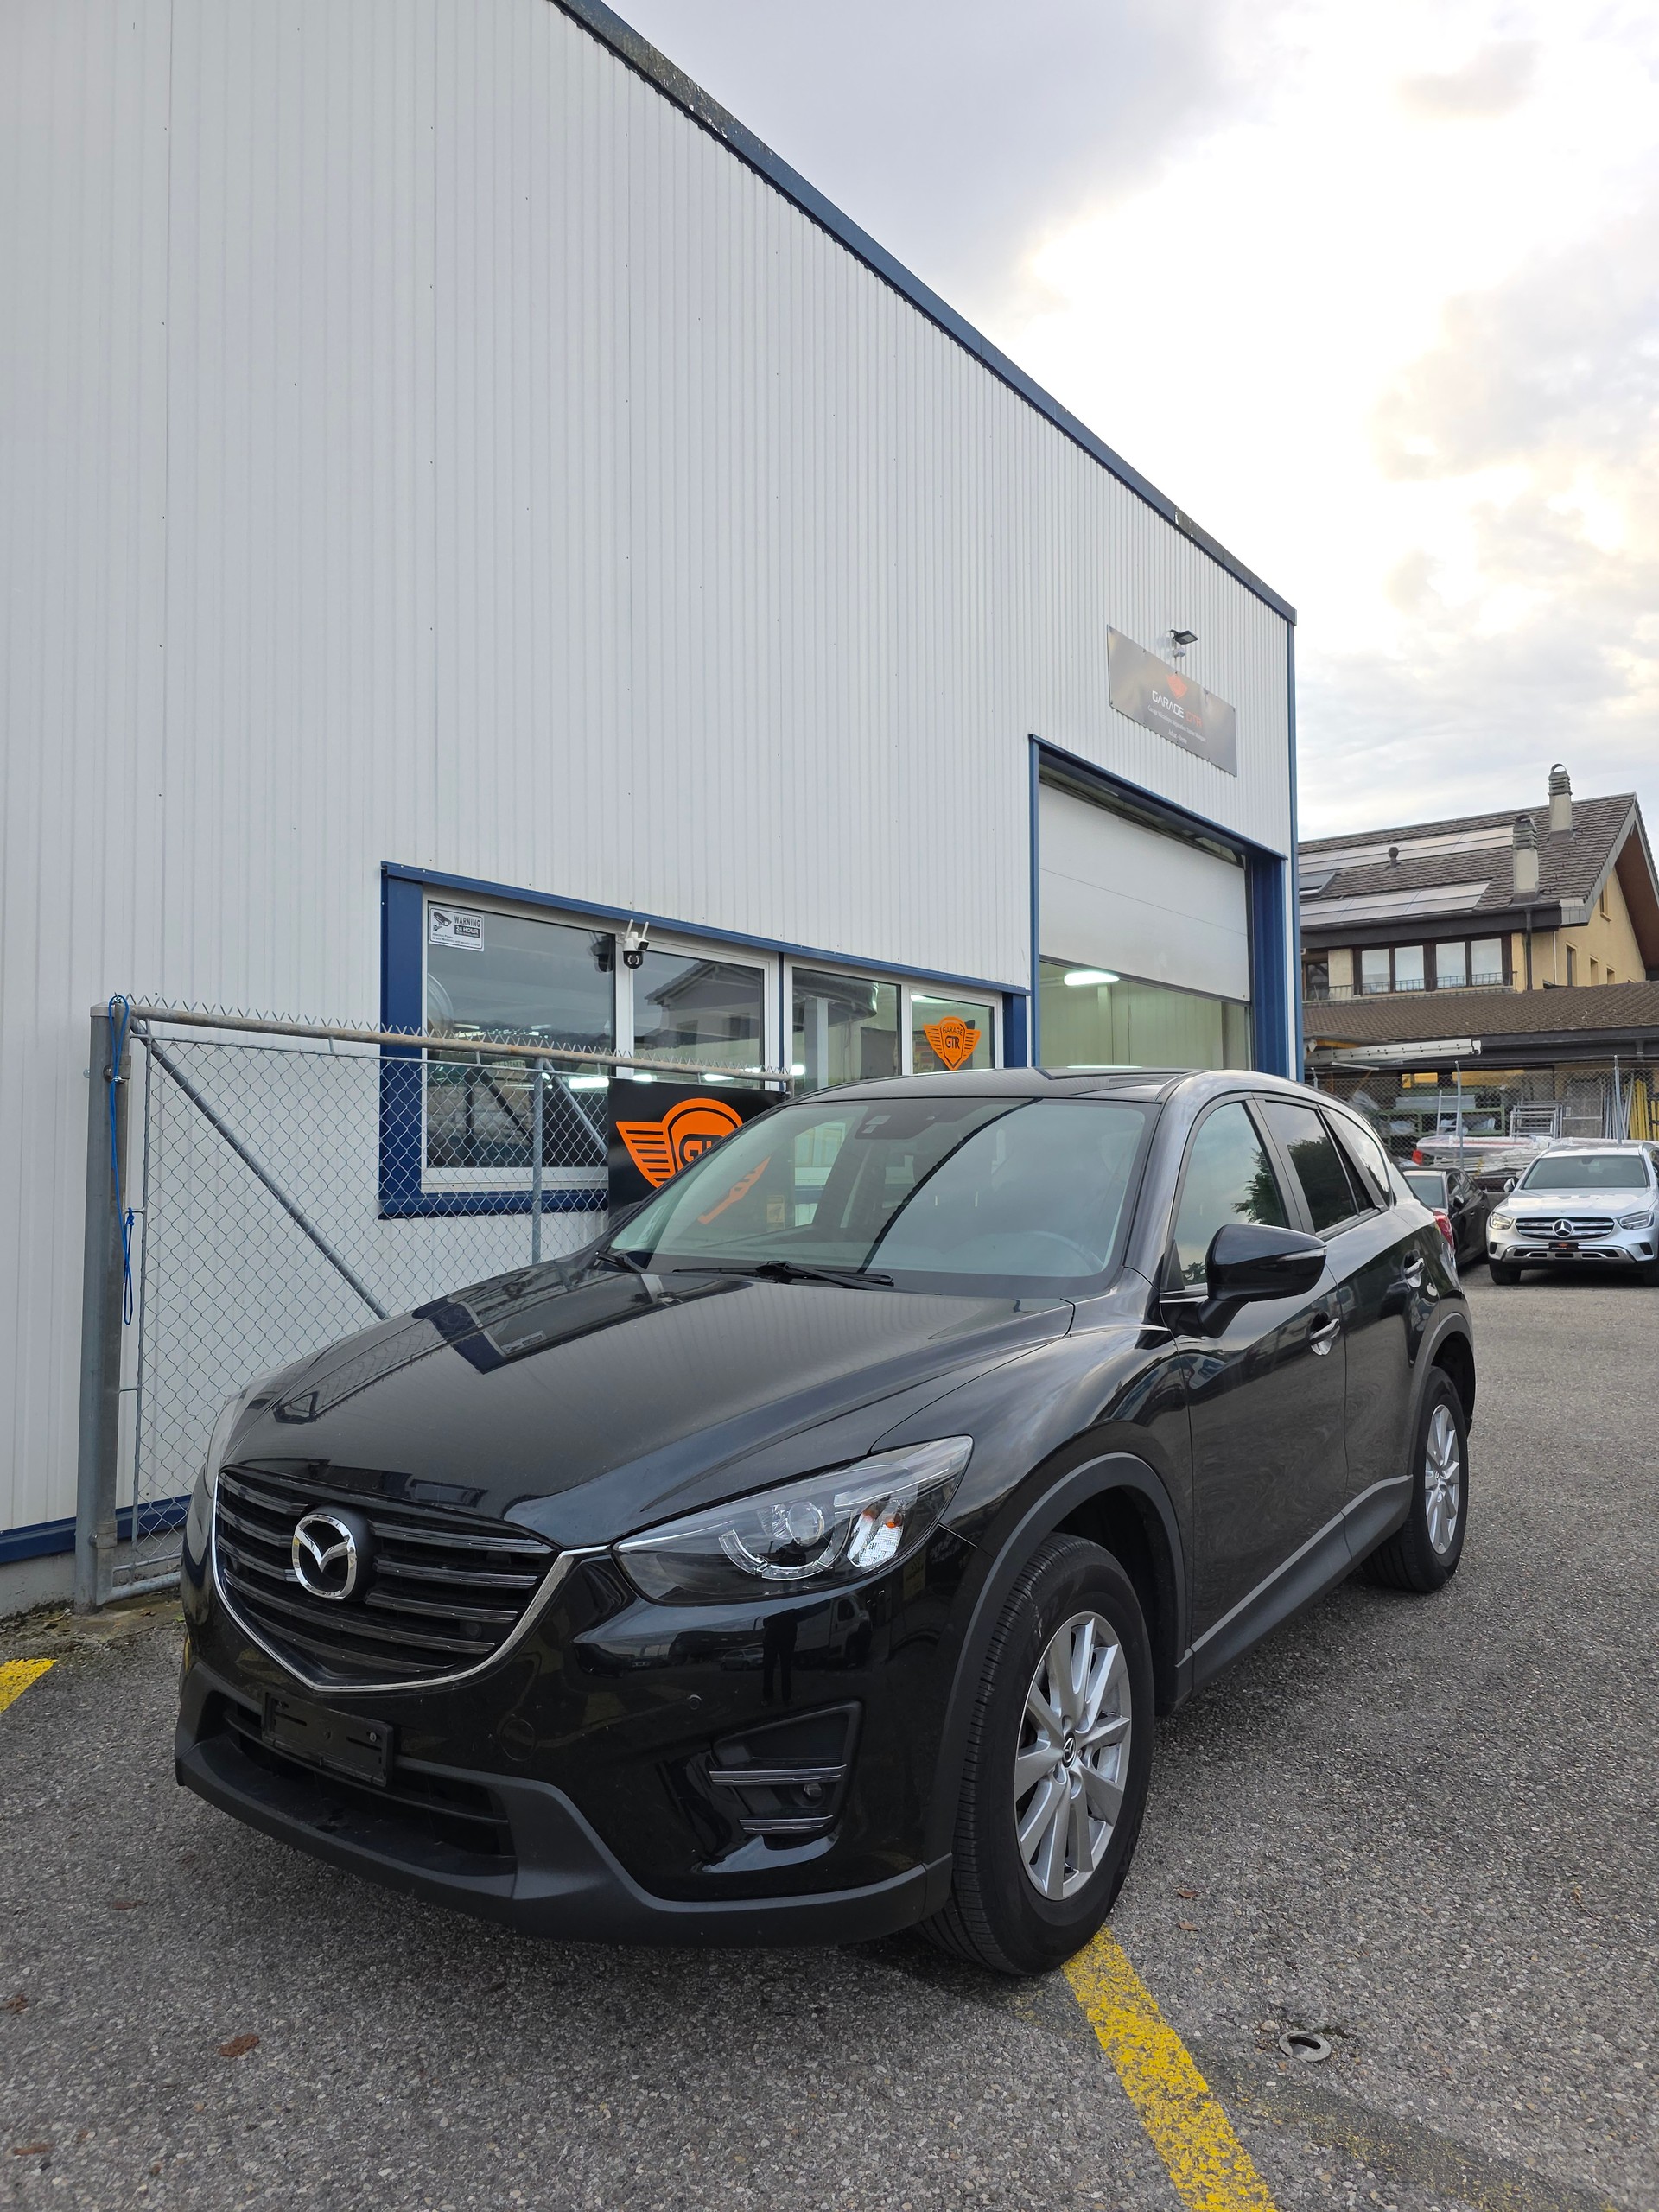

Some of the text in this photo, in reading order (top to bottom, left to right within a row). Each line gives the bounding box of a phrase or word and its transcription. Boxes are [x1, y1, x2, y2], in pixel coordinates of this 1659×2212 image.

[1152, 690, 1184, 719] GARAGE
[1185, 711, 1203, 728] GTR
[454, 916, 480, 928] WARNING
[943, 1026, 963, 1036] GARAGE
[945, 1035, 960, 1049] GTR
